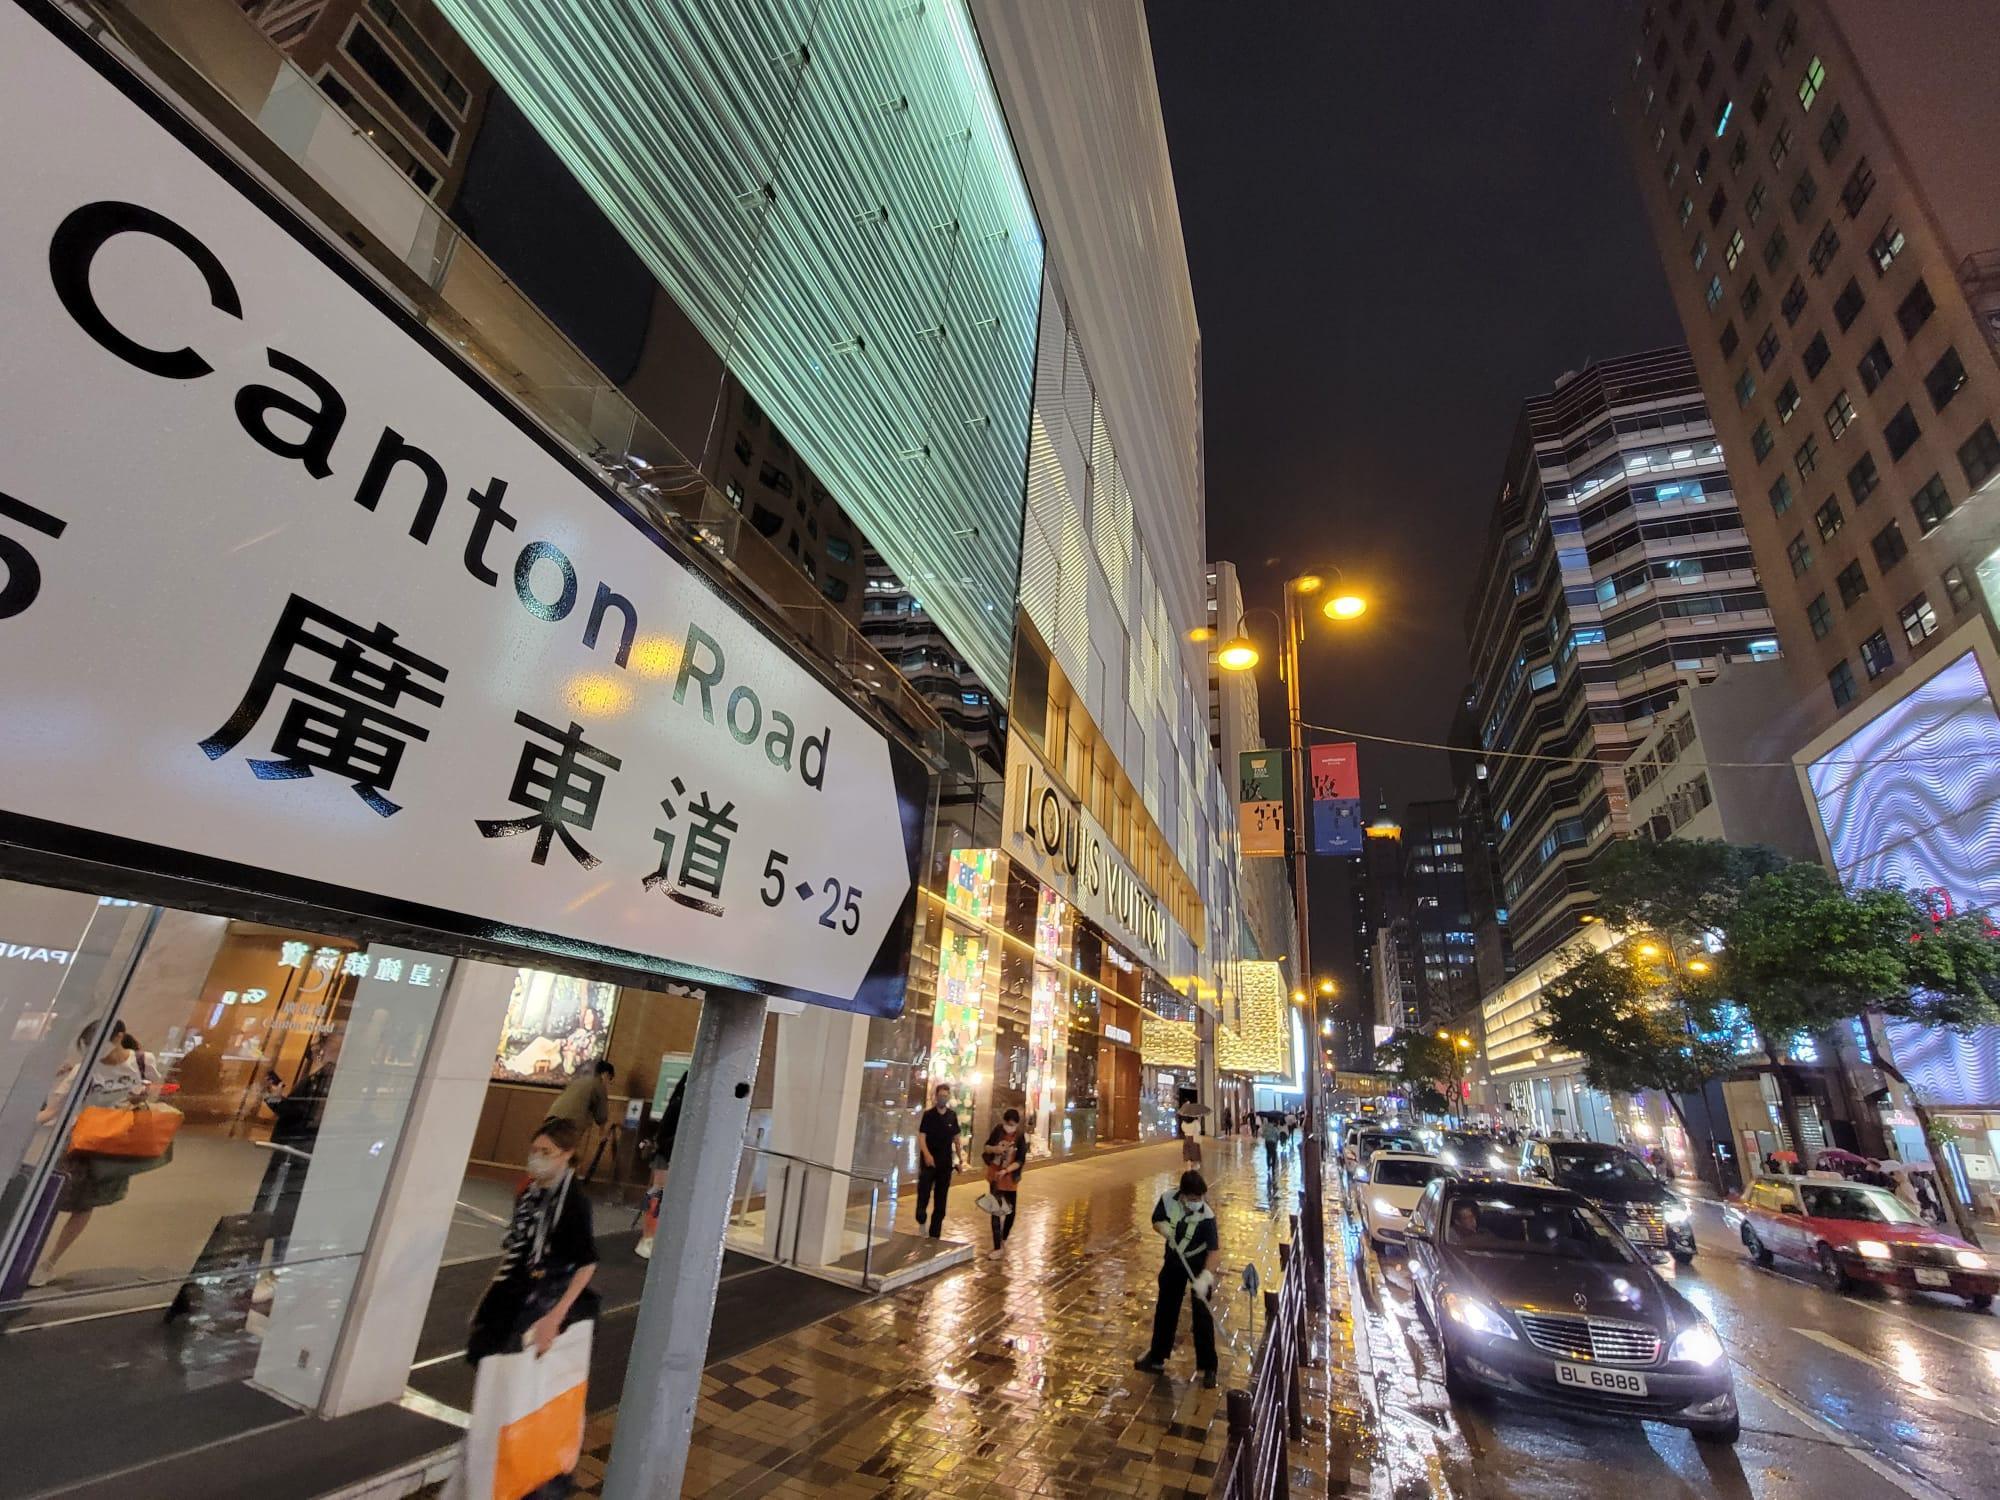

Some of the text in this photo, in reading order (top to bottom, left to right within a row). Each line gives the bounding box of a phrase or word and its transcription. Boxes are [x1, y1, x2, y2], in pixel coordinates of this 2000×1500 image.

[49, 200, 832, 792] Canton Road
[197, 592, 740, 919] 廣東道
[1018, 763, 1166, 961] LOUIS VUITTON
[1560, 1366, 1640, 1391] BL 6888
